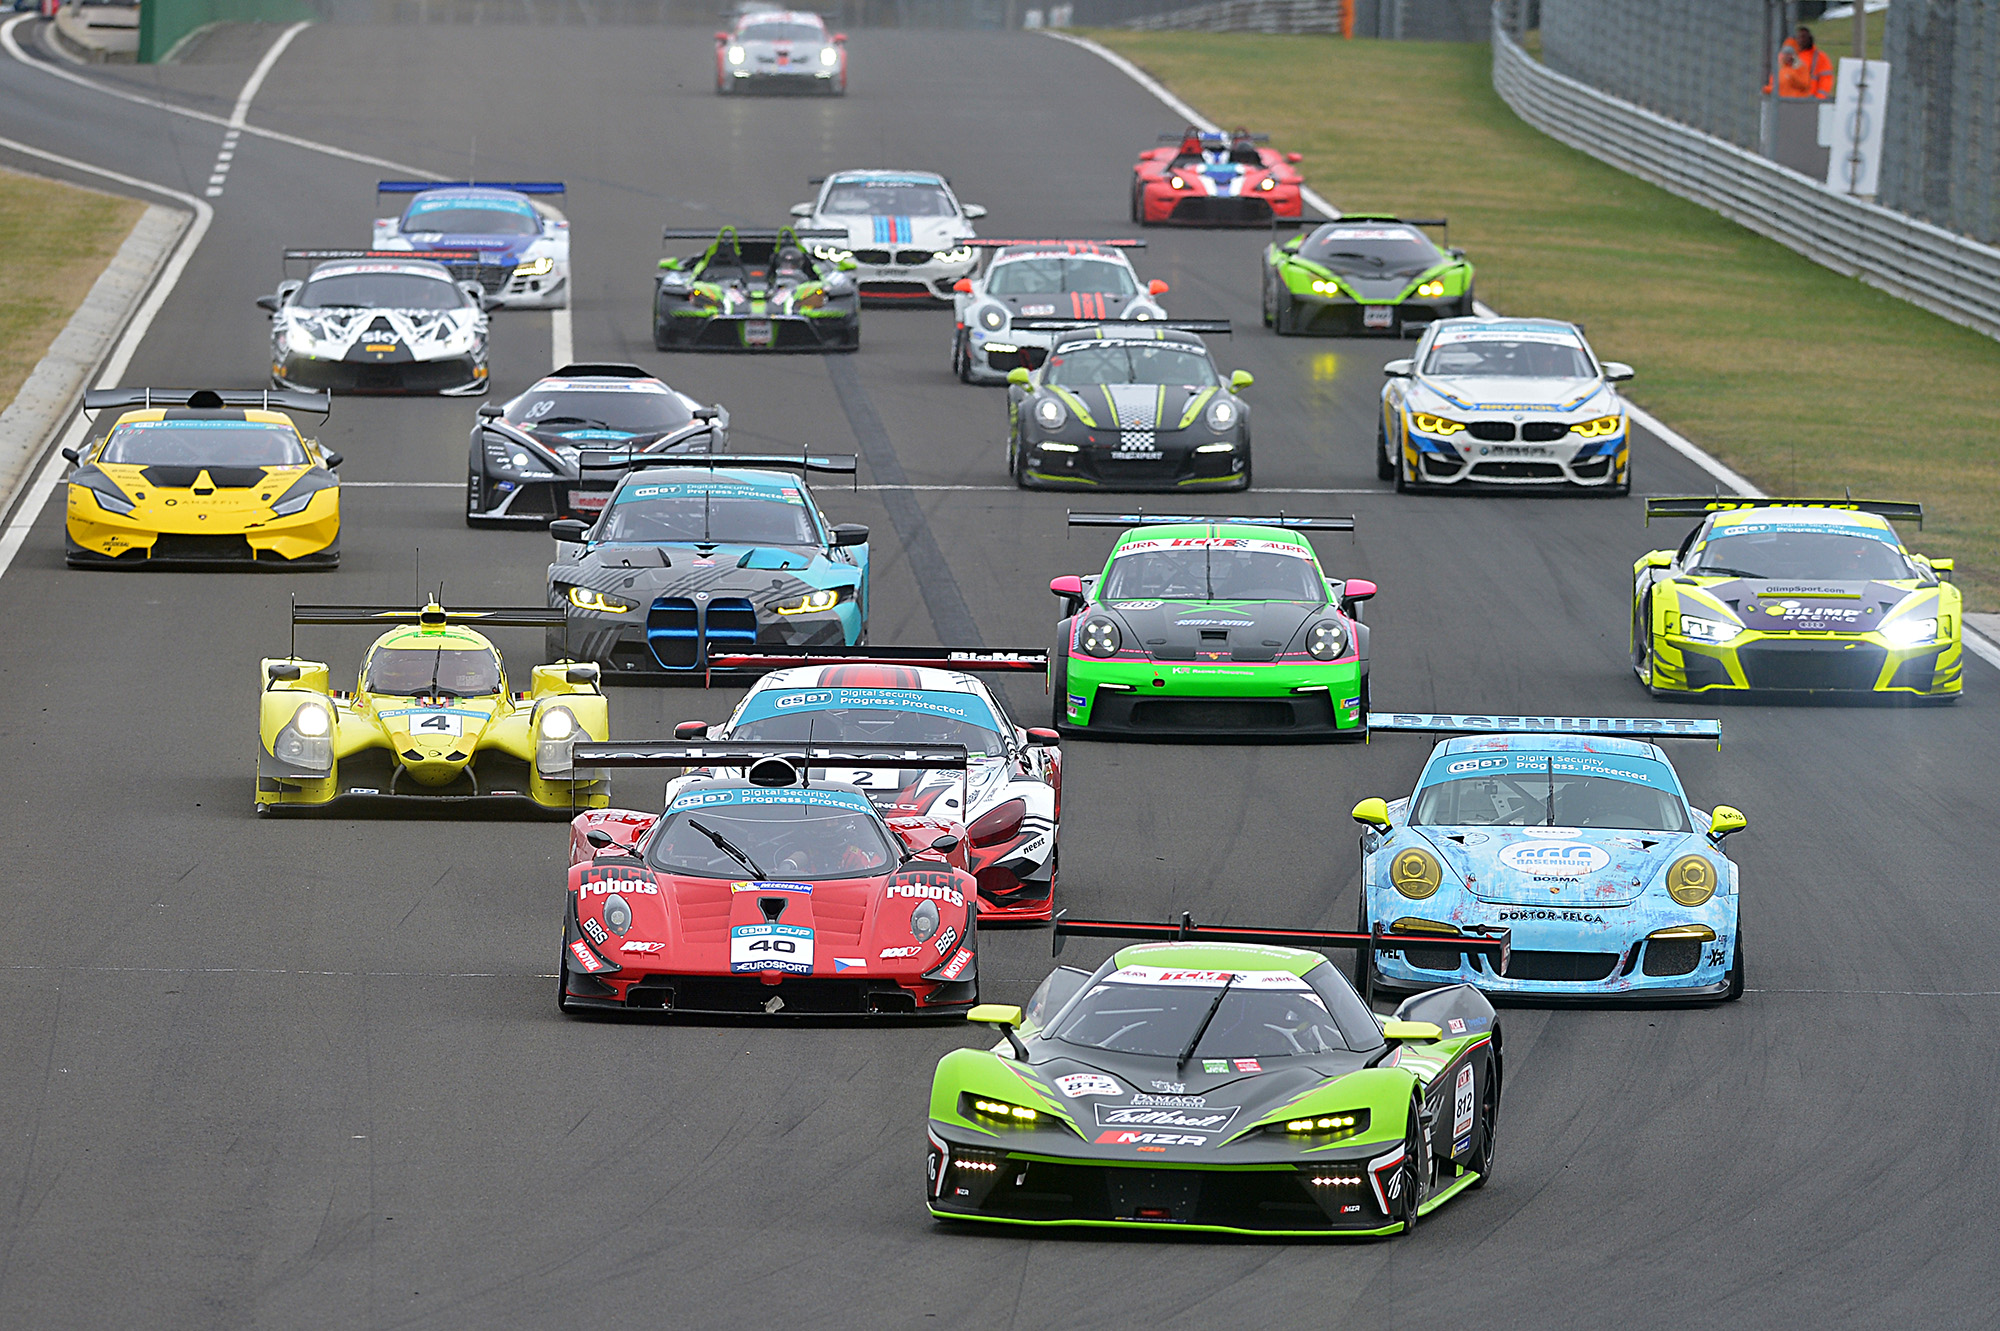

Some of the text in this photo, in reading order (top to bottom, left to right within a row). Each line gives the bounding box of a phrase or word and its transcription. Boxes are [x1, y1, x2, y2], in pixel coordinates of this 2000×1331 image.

[361, 330, 400, 344] sky
[525, 400, 555, 418] 89
[1766, 586, 1845, 594] OlimpSport.com
[1785, 607, 1861, 616] OLIMP
[879, 690, 923, 700] Security
[839, 697, 968, 717] Progress. Protected.
[421, 715, 450, 730] 4
[1557, 756, 1604, 766] Security
[852, 771, 874, 786] 2
[1516, 763, 1652, 783] Progess. Protected.
[742, 790, 831, 800] Digital Security
[1022, 837, 1047, 855] neext
[1516, 858, 1592, 867] BASENHURT
[580, 878, 658, 900] robots
[887, 883, 964, 907] robots
[1499, 912, 1605, 924] DOKTOR-FELGA
[583, 917, 609, 944] BBS
[776, 927, 810, 936] CUP
[749, 940, 795, 953] 40
[935, 926, 957, 956] BBS
[572, 941, 600, 971] MOTUL
[742, 961, 809, 973] EUROSPORT
[944, 949, 971, 978] MOTUL
[1132, 1094, 1206, 1105] PAMACO
[1456, 1092, 1472, 1118] 812
[1117, 1133, 1207, 1146] MZR
